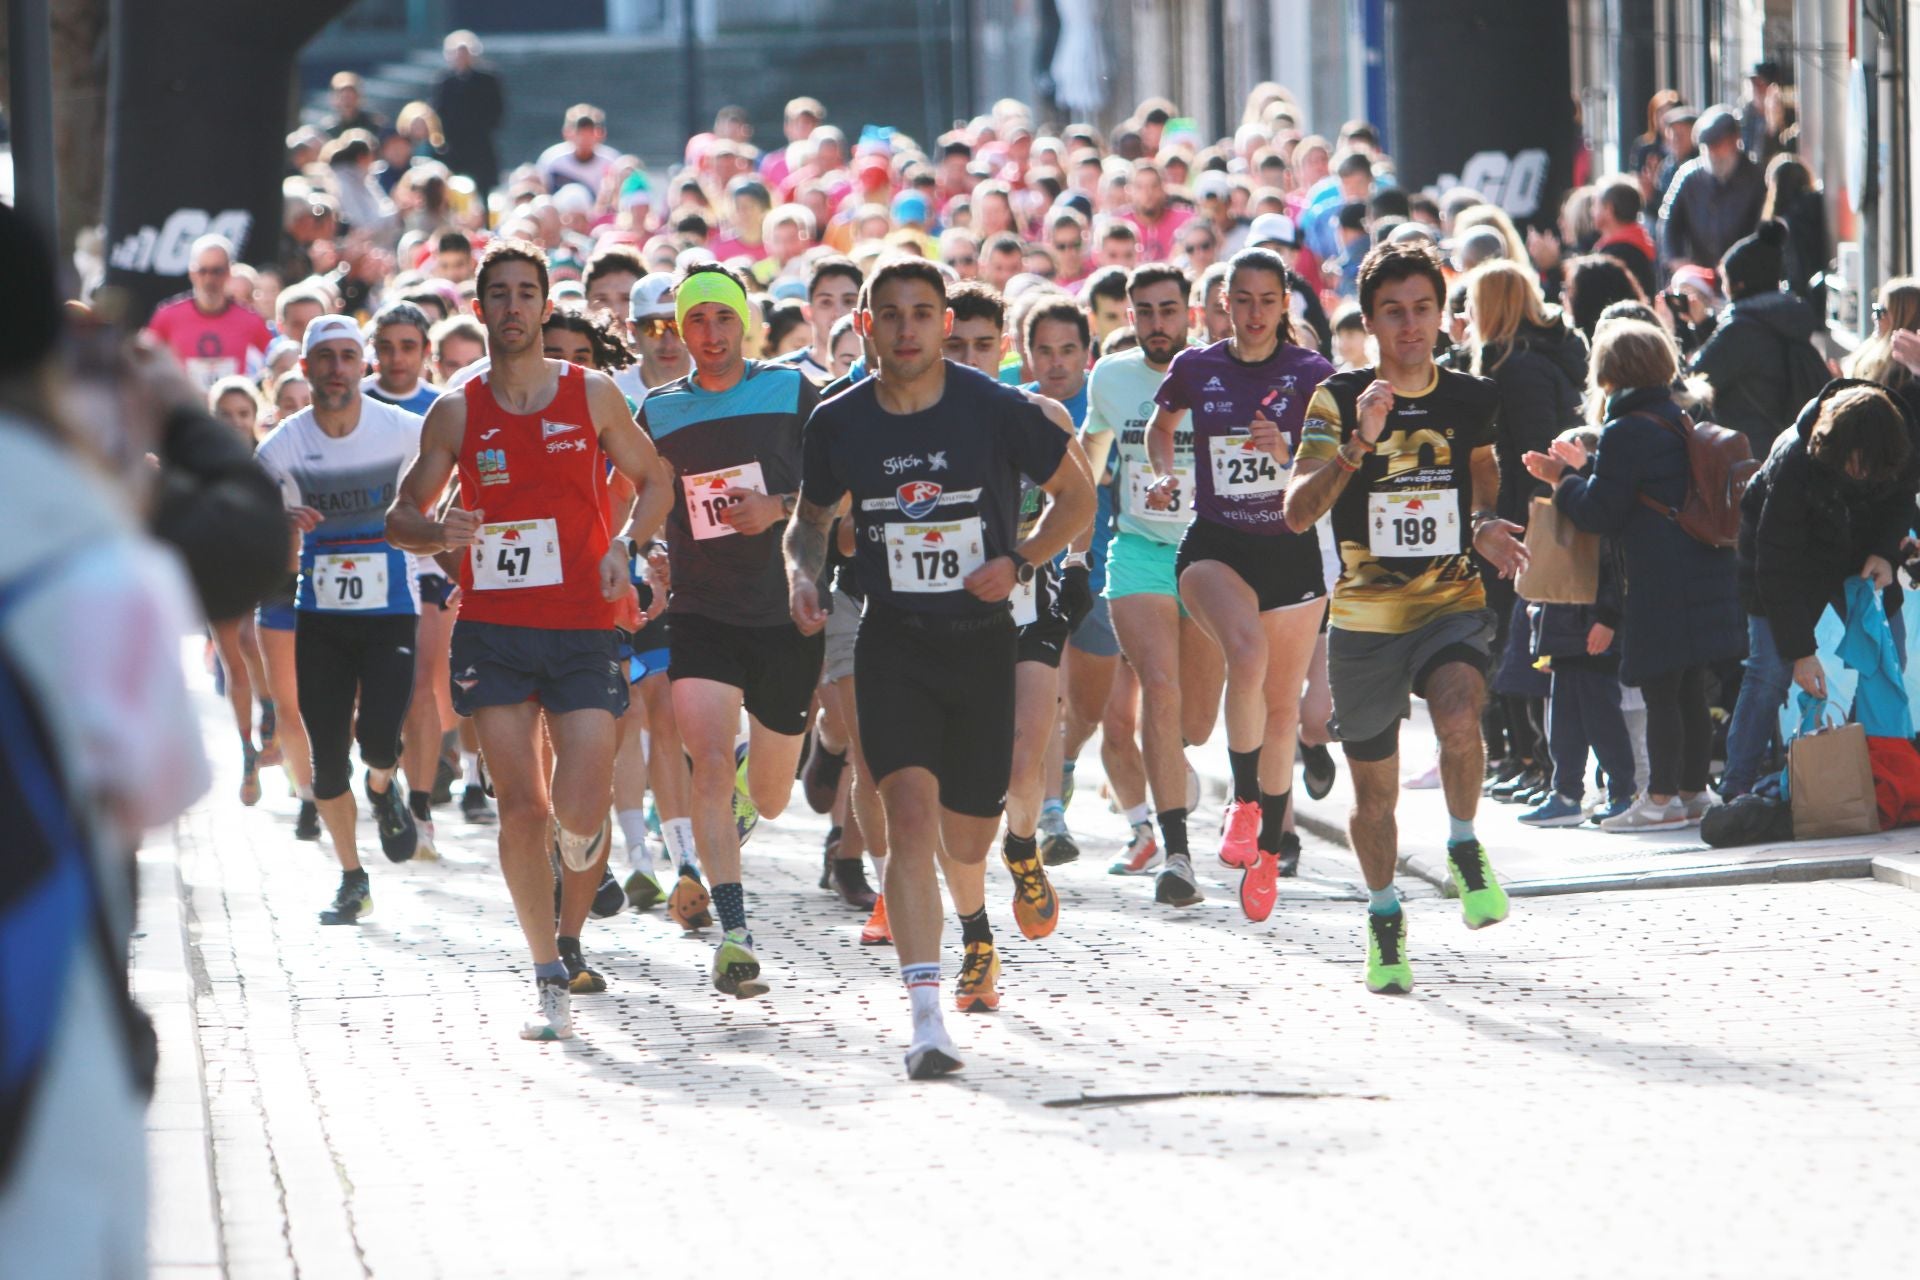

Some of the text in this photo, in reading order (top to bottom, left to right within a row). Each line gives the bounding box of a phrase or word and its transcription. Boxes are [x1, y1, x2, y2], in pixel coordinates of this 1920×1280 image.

[883, 454, 923, 475] gijón
[1227, 457, 1276, 484] 234
[1392, 517, 1437, 546] 198
[497, 547, 531, 576] 47
[912, 550, 960, 580] 178
[335, 576, 363, 600] 70
